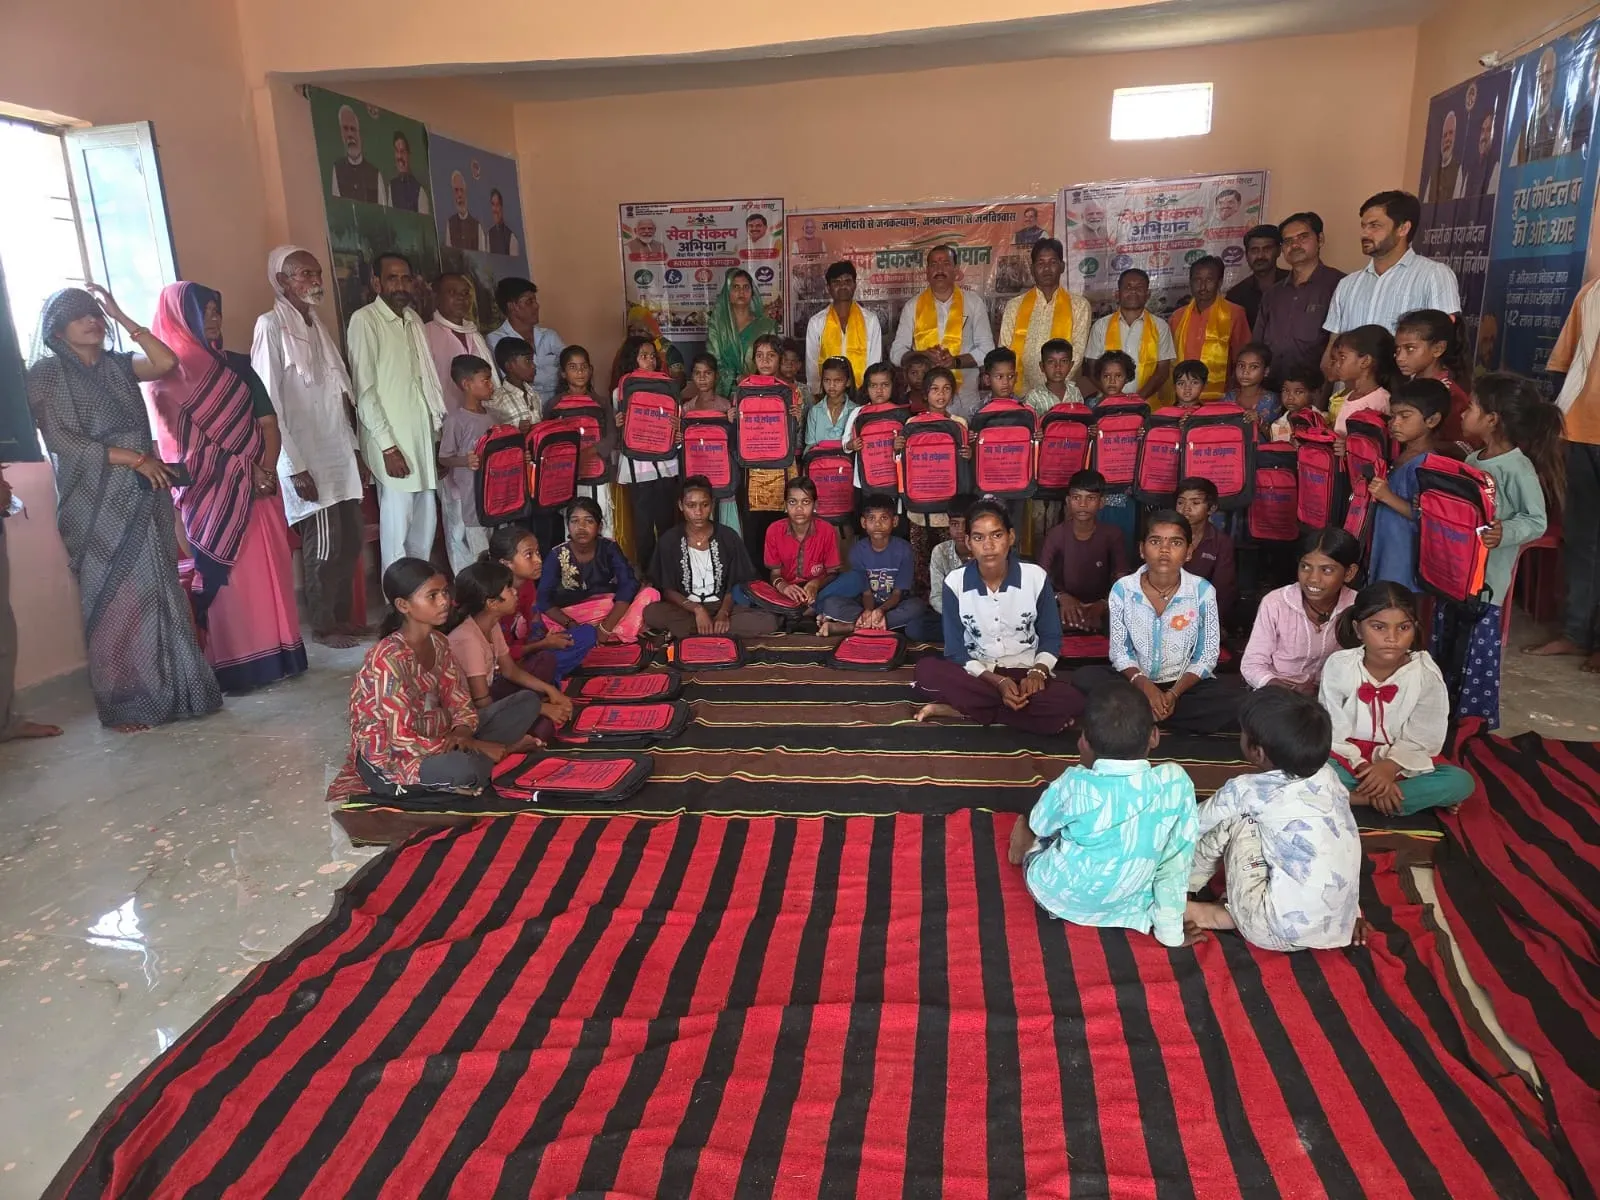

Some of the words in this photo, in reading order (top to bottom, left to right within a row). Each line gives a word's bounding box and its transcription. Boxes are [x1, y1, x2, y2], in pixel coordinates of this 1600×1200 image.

[822, 218, 865, 231] जनभागीदारी
[868, 217, 874, 228] से
[1131, 220, 1190, 236] अभियान
[666, 226, 693, 240] सेवा
[697, 226, 738, 240] संकल्प
[679, 239, 726, 252] अभियान
[876, 246, 923, 269] संकल्प
